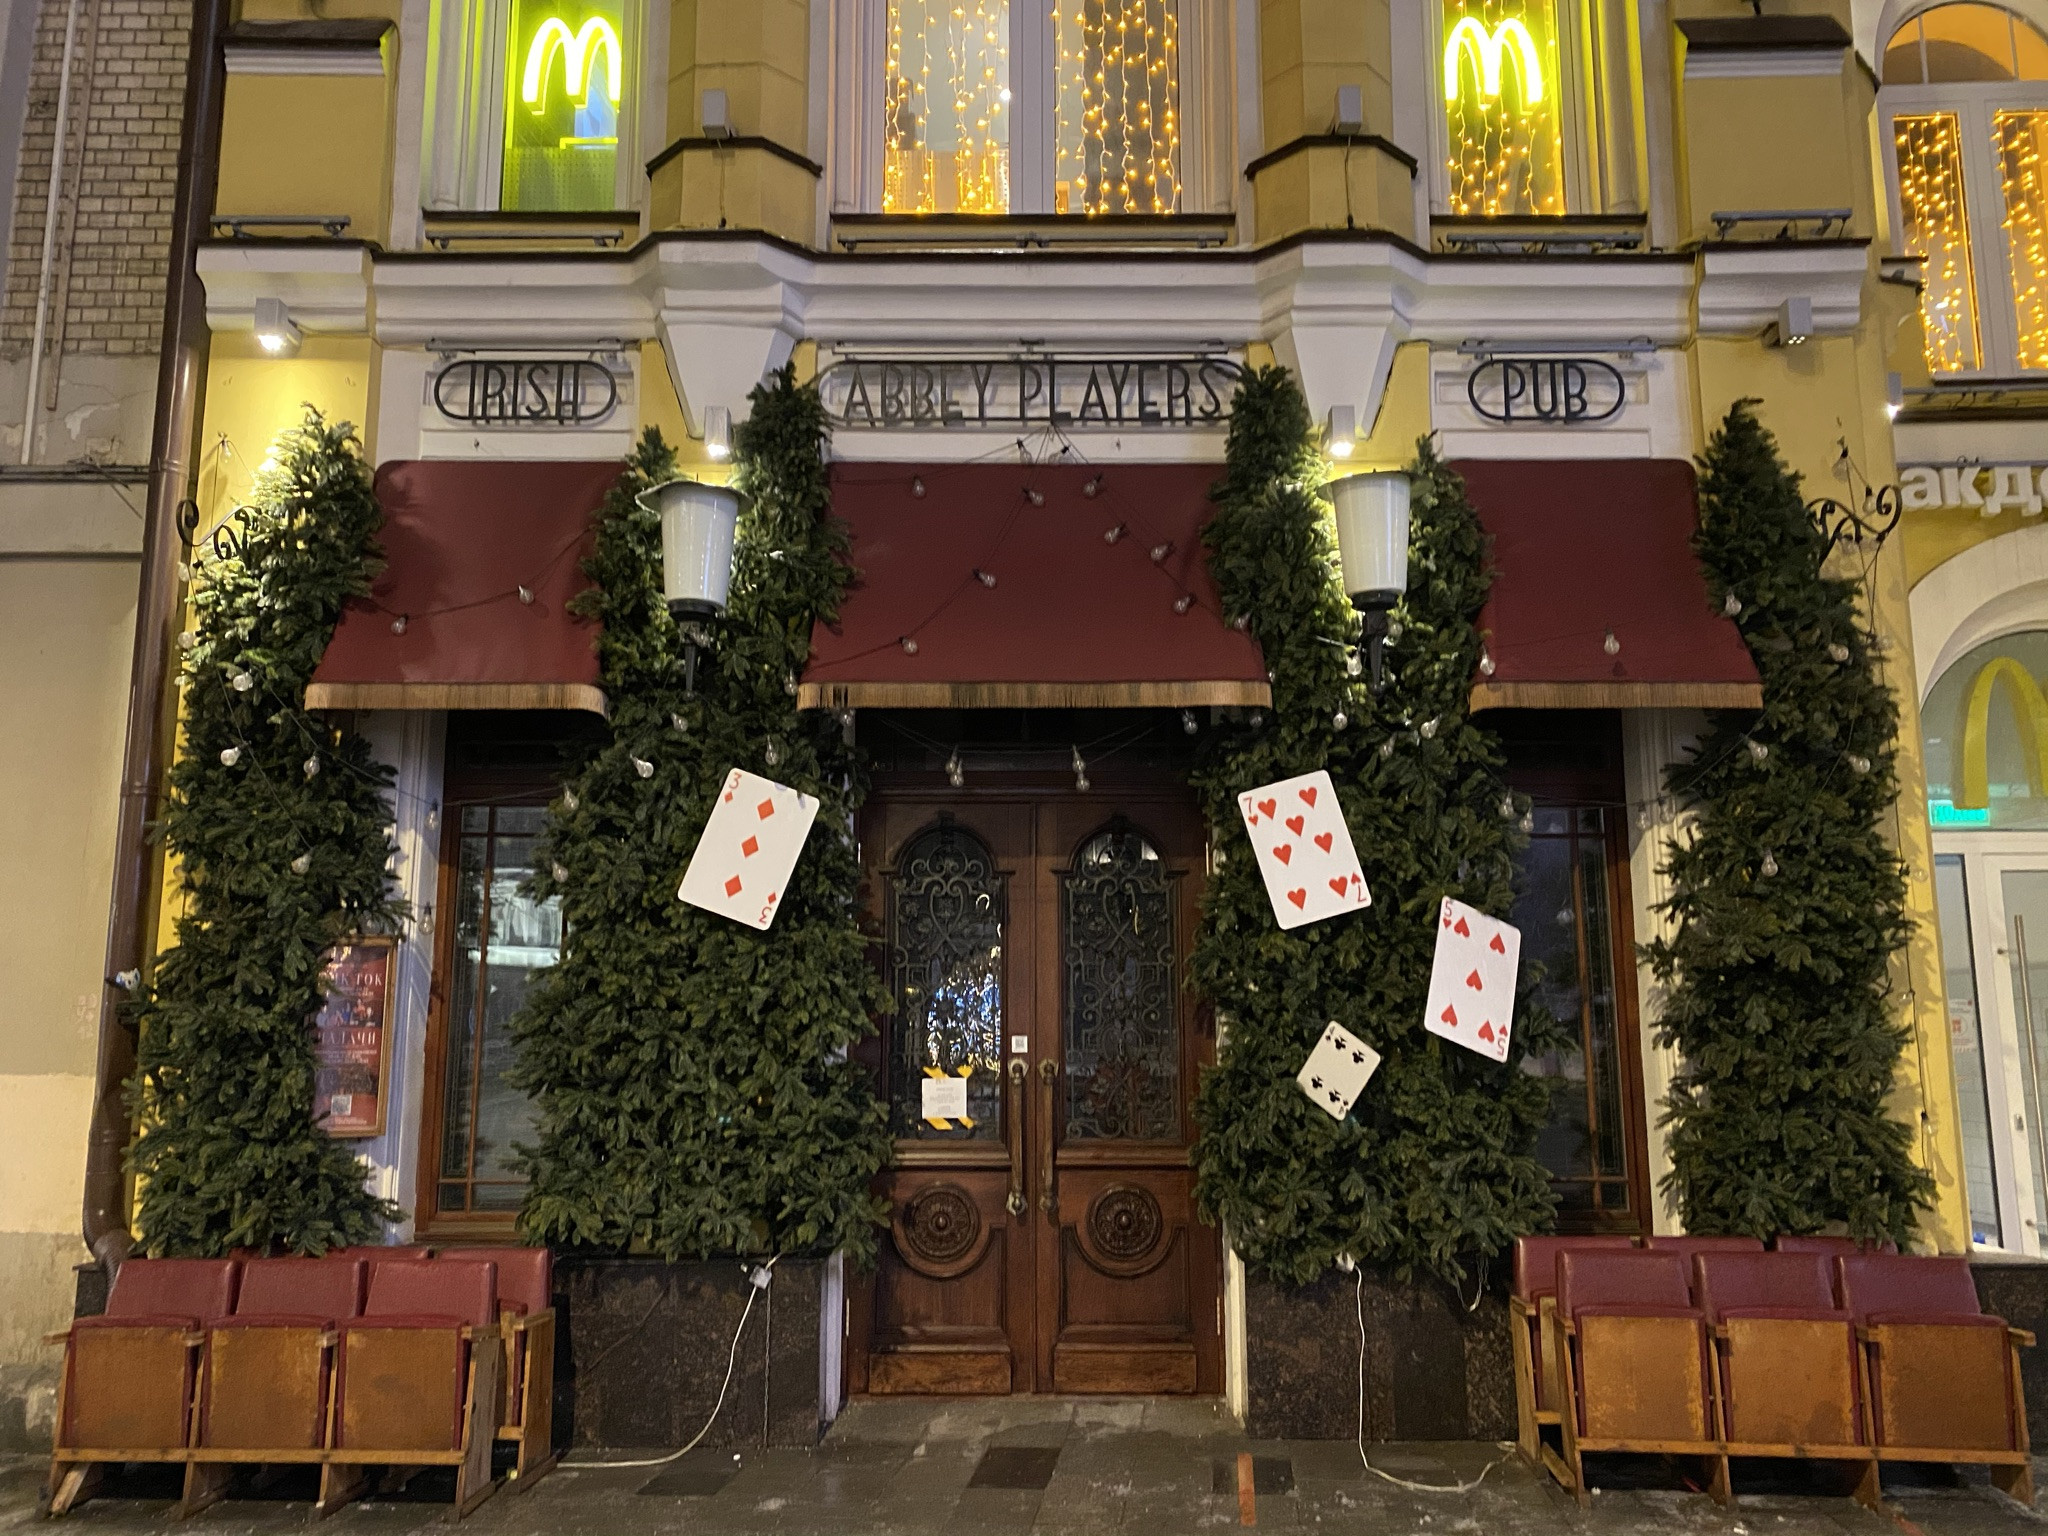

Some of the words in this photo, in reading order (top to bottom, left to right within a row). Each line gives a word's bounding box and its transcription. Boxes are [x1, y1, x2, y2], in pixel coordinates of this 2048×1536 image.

[468, 360, 581, 422] IRISH
[843, 361, 992, 427] ABBEY
[1018, 361, 1221, 427] PLAYERS
[1502, 360, 1588, 423] PUB
[729, 772, 742, 789] 3
[1243, 797, 1253, 814] 7
[1357, 885, 1367, 902] 7
[758, 906, 772, 924] 3
[1444, 900, 1454, 917] 5
[1497, 1038, 1506, 1056] 5
